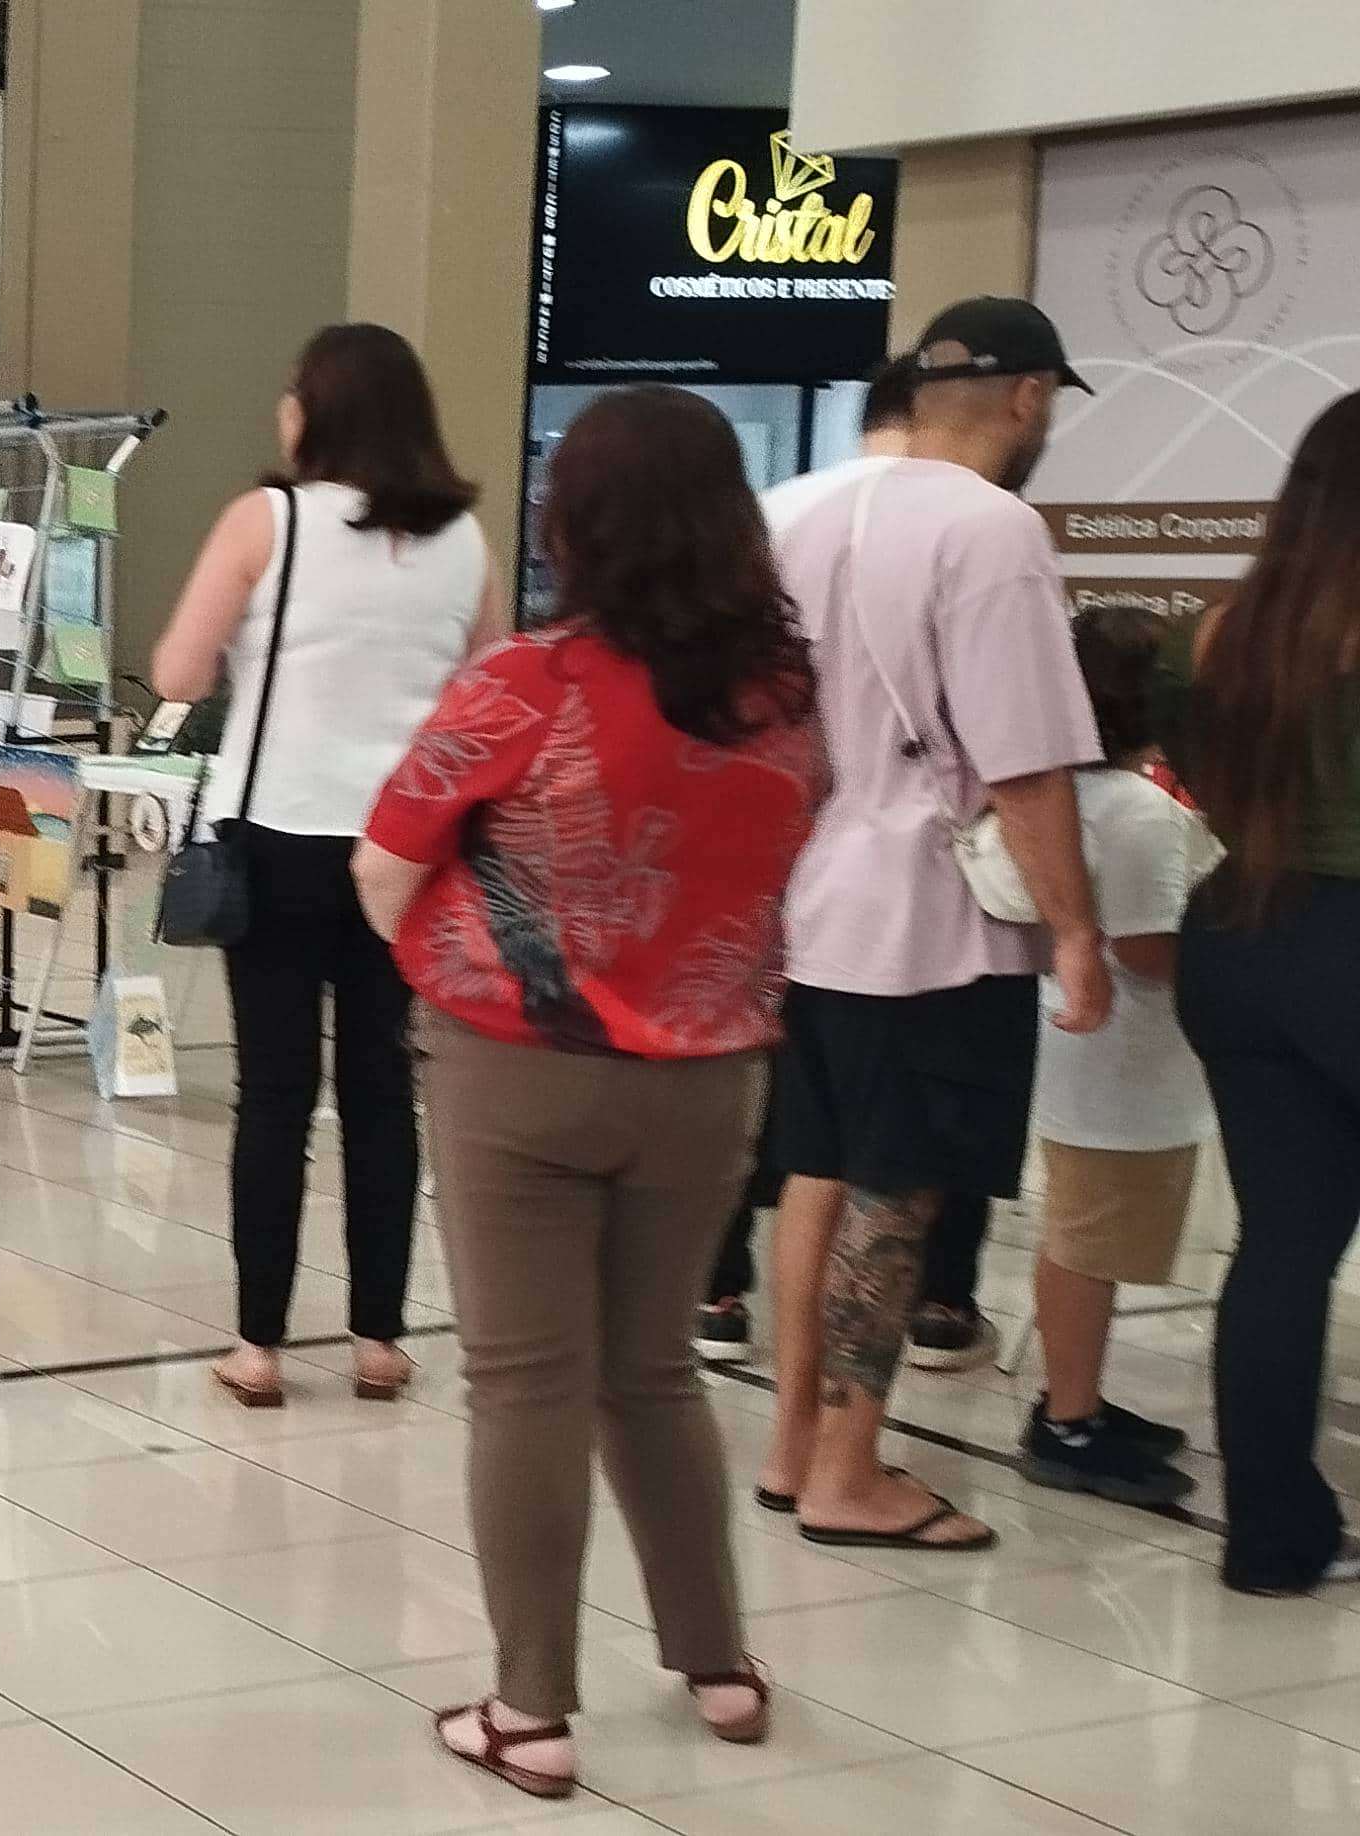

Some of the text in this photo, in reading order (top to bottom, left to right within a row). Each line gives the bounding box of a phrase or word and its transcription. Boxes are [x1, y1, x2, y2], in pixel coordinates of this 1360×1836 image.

[687, 159, 876, 265] Cristal
[777, 277, 793, 299] E
[1065, 512, 1267, 543] Estética Corporal
